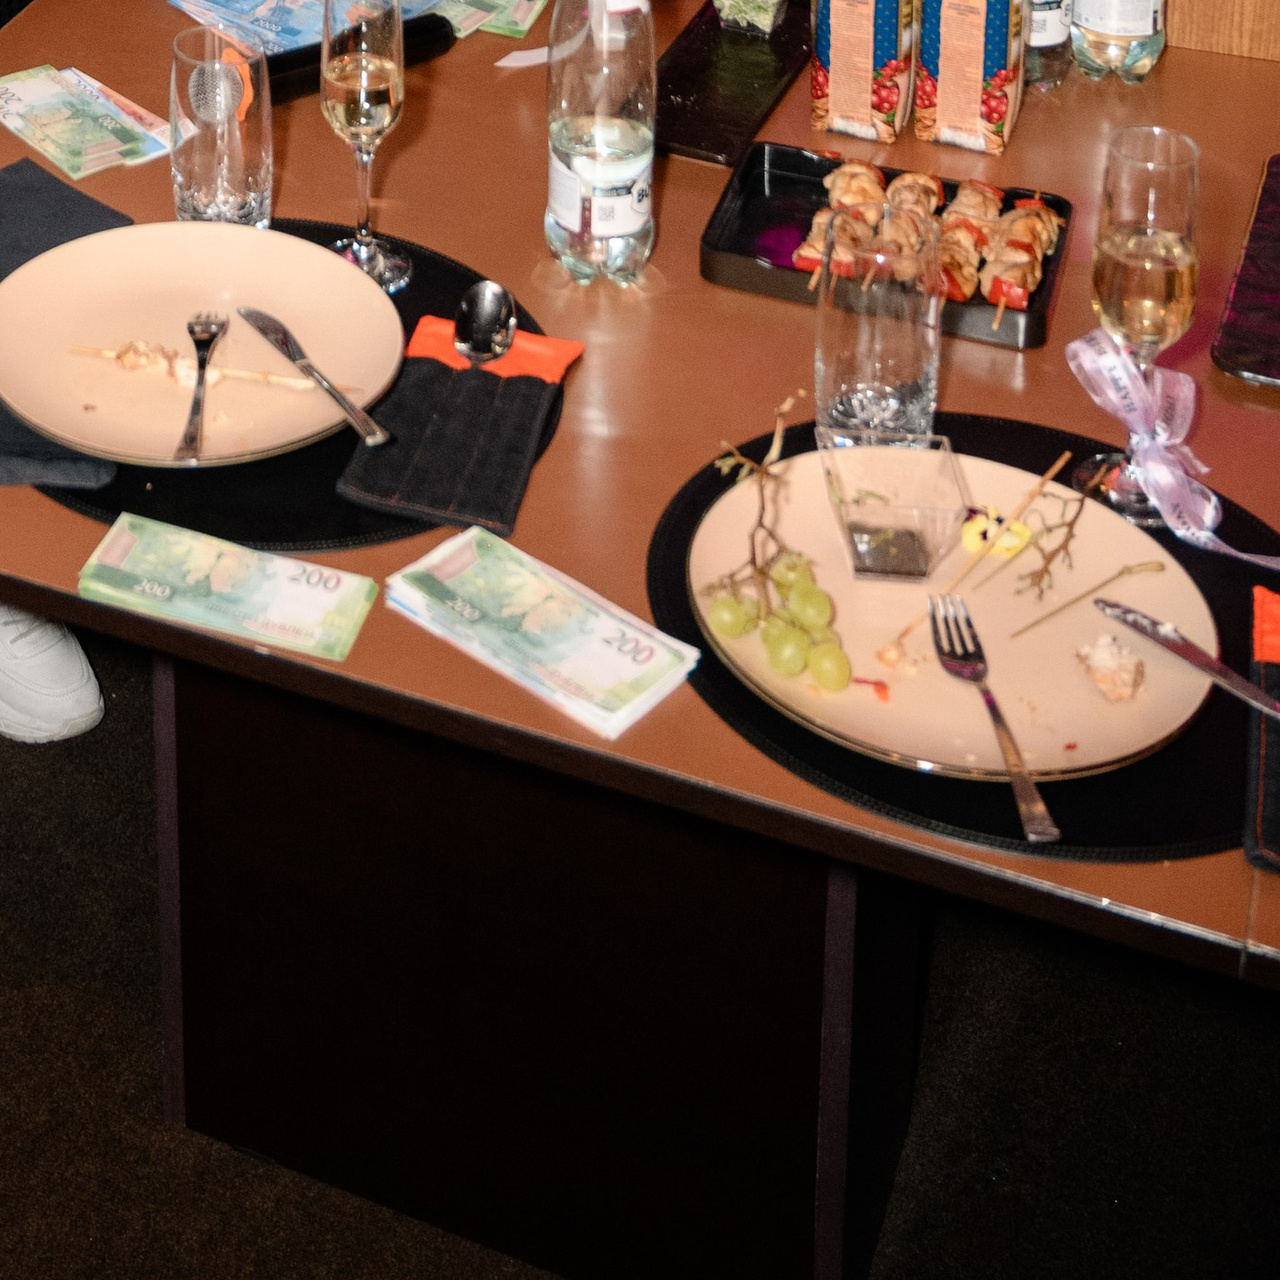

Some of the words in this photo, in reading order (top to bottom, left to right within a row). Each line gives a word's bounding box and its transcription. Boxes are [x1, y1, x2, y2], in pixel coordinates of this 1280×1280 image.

[132, 577, 170, 598] 200
[287, 563, 342, 591] 200
[445, 596, 481, 622] 200
[602, 628, 656, 666] 200
